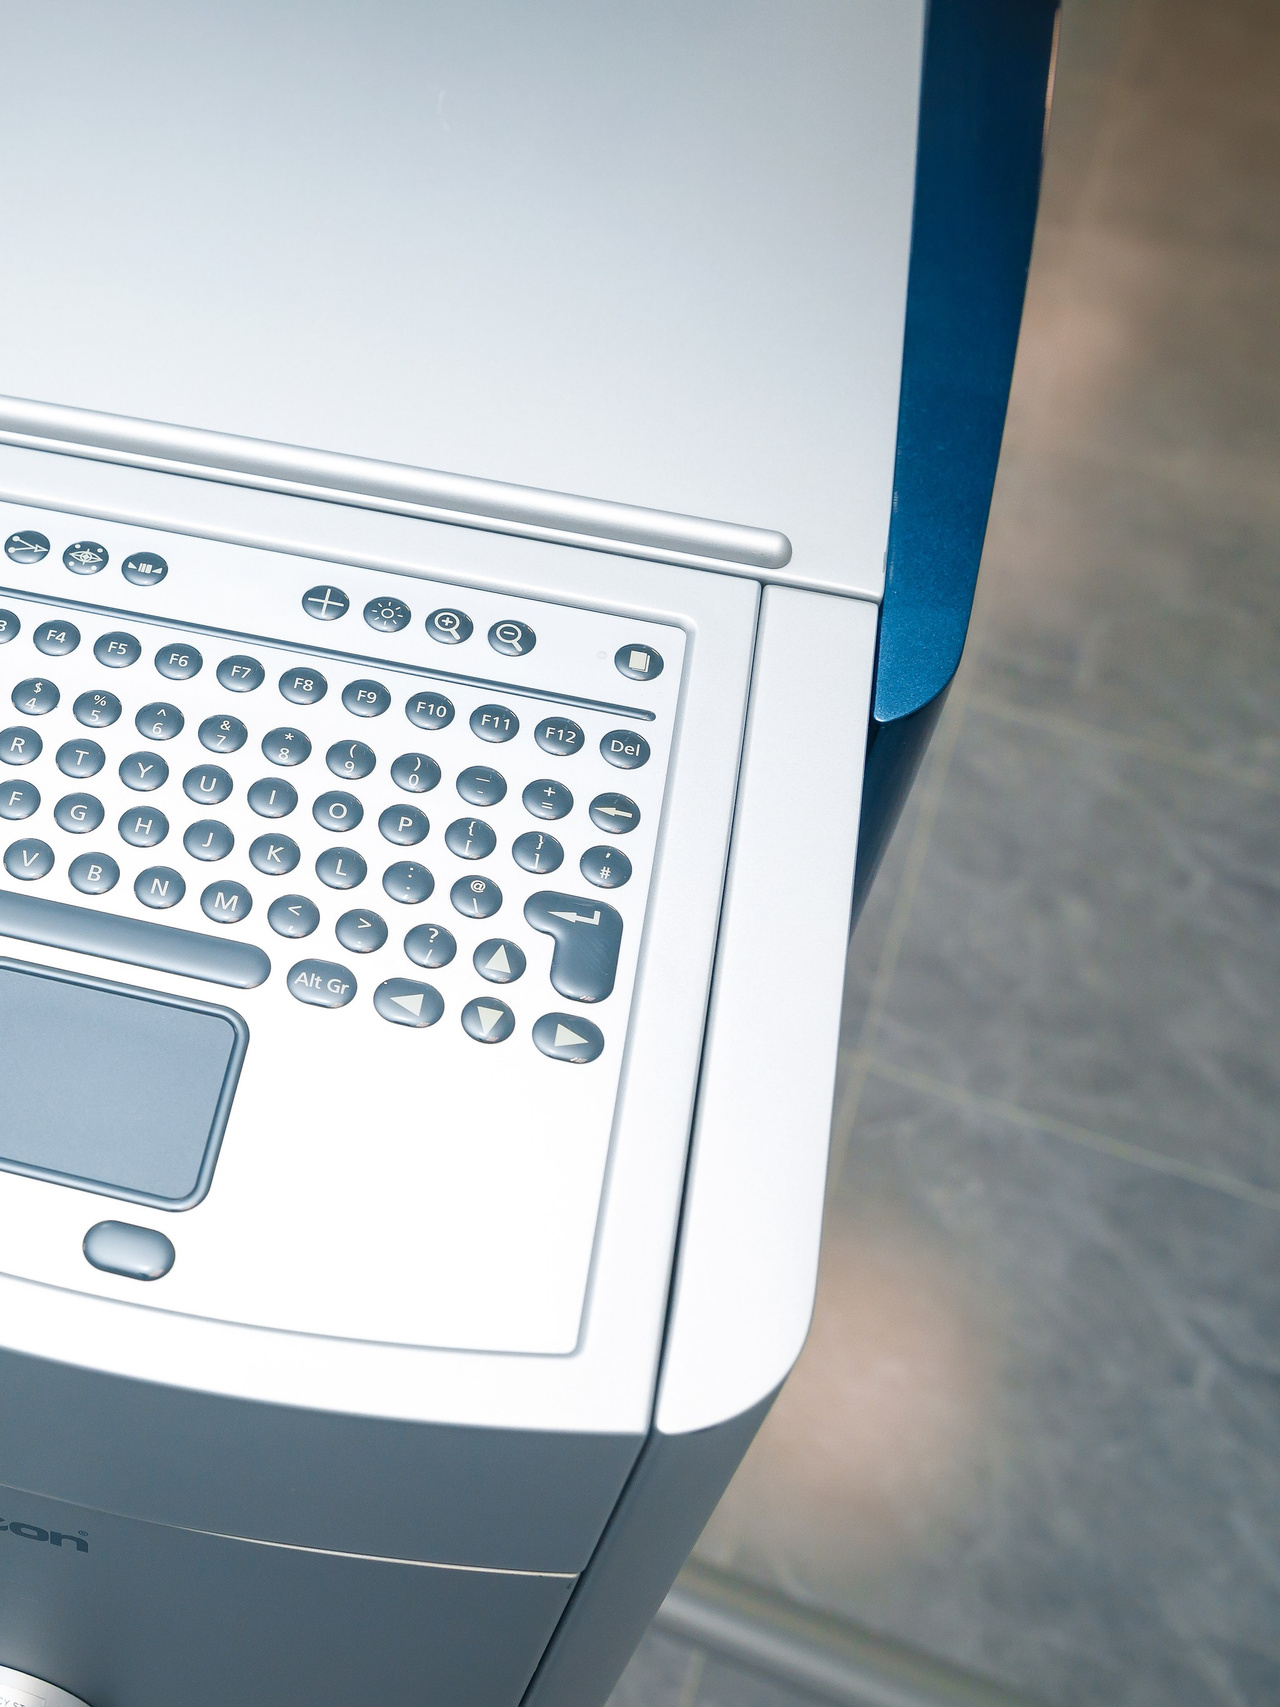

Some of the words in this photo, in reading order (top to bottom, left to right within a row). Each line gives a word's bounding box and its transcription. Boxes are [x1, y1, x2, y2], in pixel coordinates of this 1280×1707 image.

[47, 630, 66, 643] F4
[108, 642, 127, 654] F5
[170, 654, 189, 666] F6
[232, 666, 251, 678] F7
[34, 682, 42, 693] $
[294, 678, 313, 691] F8
[25, 697, 37, 709] 4
[94, 695, 106, 706] %
[357, 690, 376, 703] F9
[89, 709, 100, 721] 5
[417, 702, 446, 717] F10
[152, 722, 162, 735] 6
[221, 721, 230, 730] &
[482, 714, 510, 730] F11
[216, 735, 227, 746] 7
[546, 727, 576, 743] F12
[11, 737, 25, 752] R
[611, 740, 640, 756] Del
[76, 750, 89, 765] T
[278, 747, 290, 760] 8
[138, 763, 153, 778] Y
[344, 760, 355, 774] 9
[200, 776, 216, 791] U
[408, 773, 419, 786] 0
[9, 791, 23, 805] F
[270, 790, 276, 804] I
[71, 805, 87, 820] G
[329, 803, 347, 818] O
[135, 818, 152, 834] H
[399, 817, 412, 831] P
[202, 833, 213, 847] J
[23, 850, 39, 866] V
[268, 845, 284, 862] K
[88, 865, 102, 881] B
[336, 859, 346, 876] L
[600, 867, 611, 879] #
[151, 879, 169, 896] N
[471, 880, 485, 892] @
[215, 892, 238, 911] M
[429, 928, 438, 943] ?
[294, 972, 322, 989] Alt
[327, 979, 349, 994] Gr
